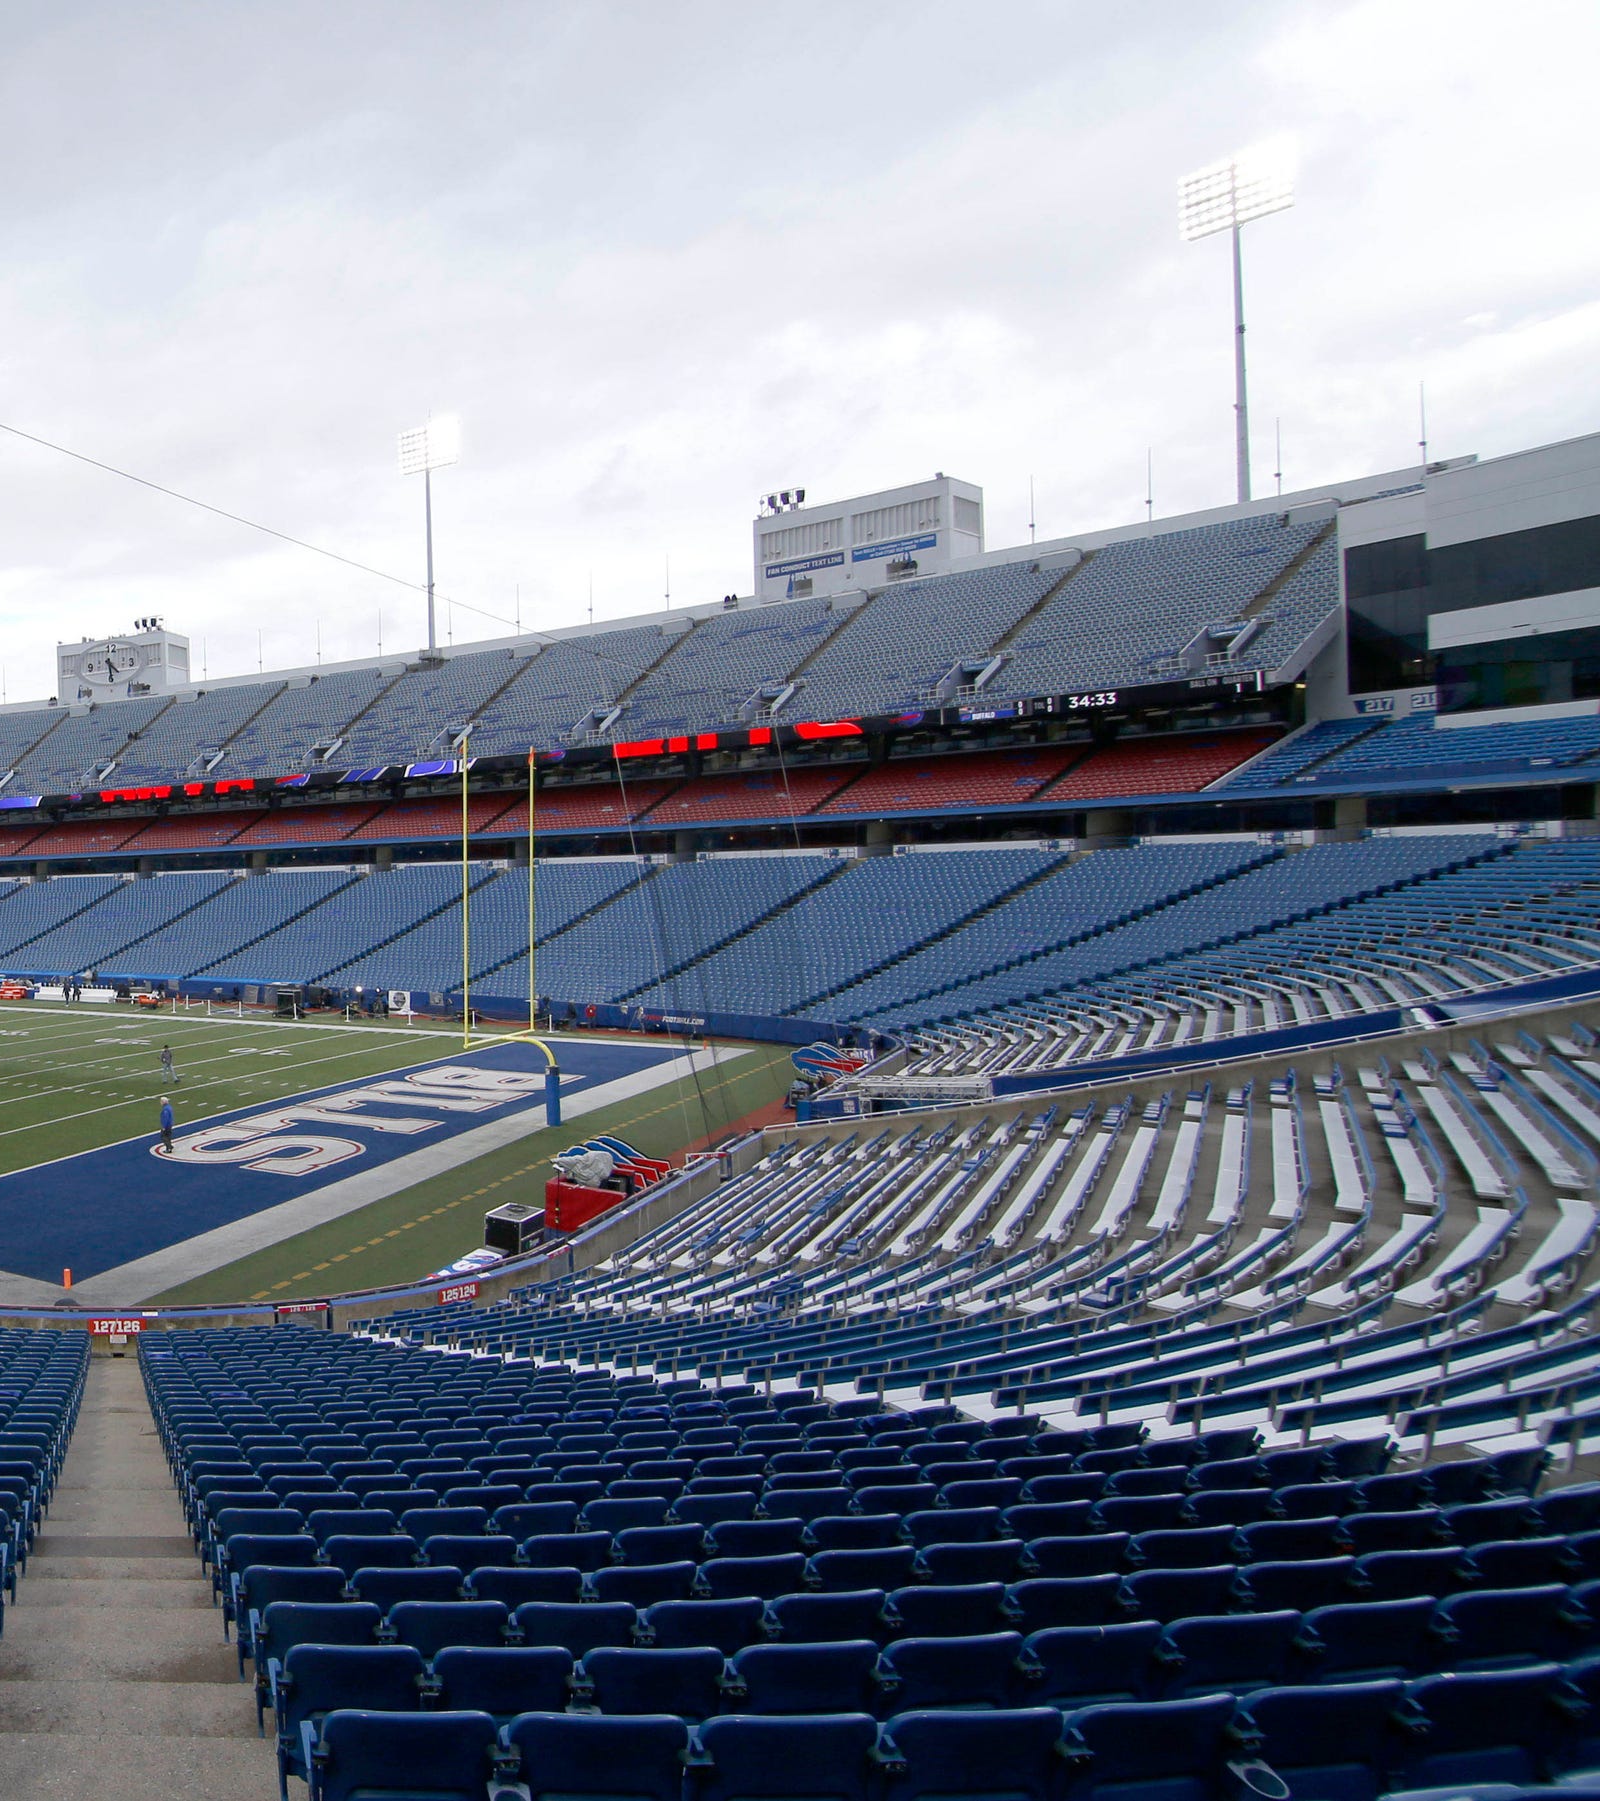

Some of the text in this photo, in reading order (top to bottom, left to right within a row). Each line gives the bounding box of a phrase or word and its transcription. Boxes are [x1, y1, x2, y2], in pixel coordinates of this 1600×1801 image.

[767, 567, 780, 576] FAN
[811, 558, 826, 568] TEXT
[827, 555, 843, 565] LINE
[106, 644, 117, 654] 12
[87, 658, 135, 672] 9 3
[1068, 692, 1117, 709] 34:33
[1365, 698, 1393, 713] 217
[972, 712, 996, 720] BUFFALO
